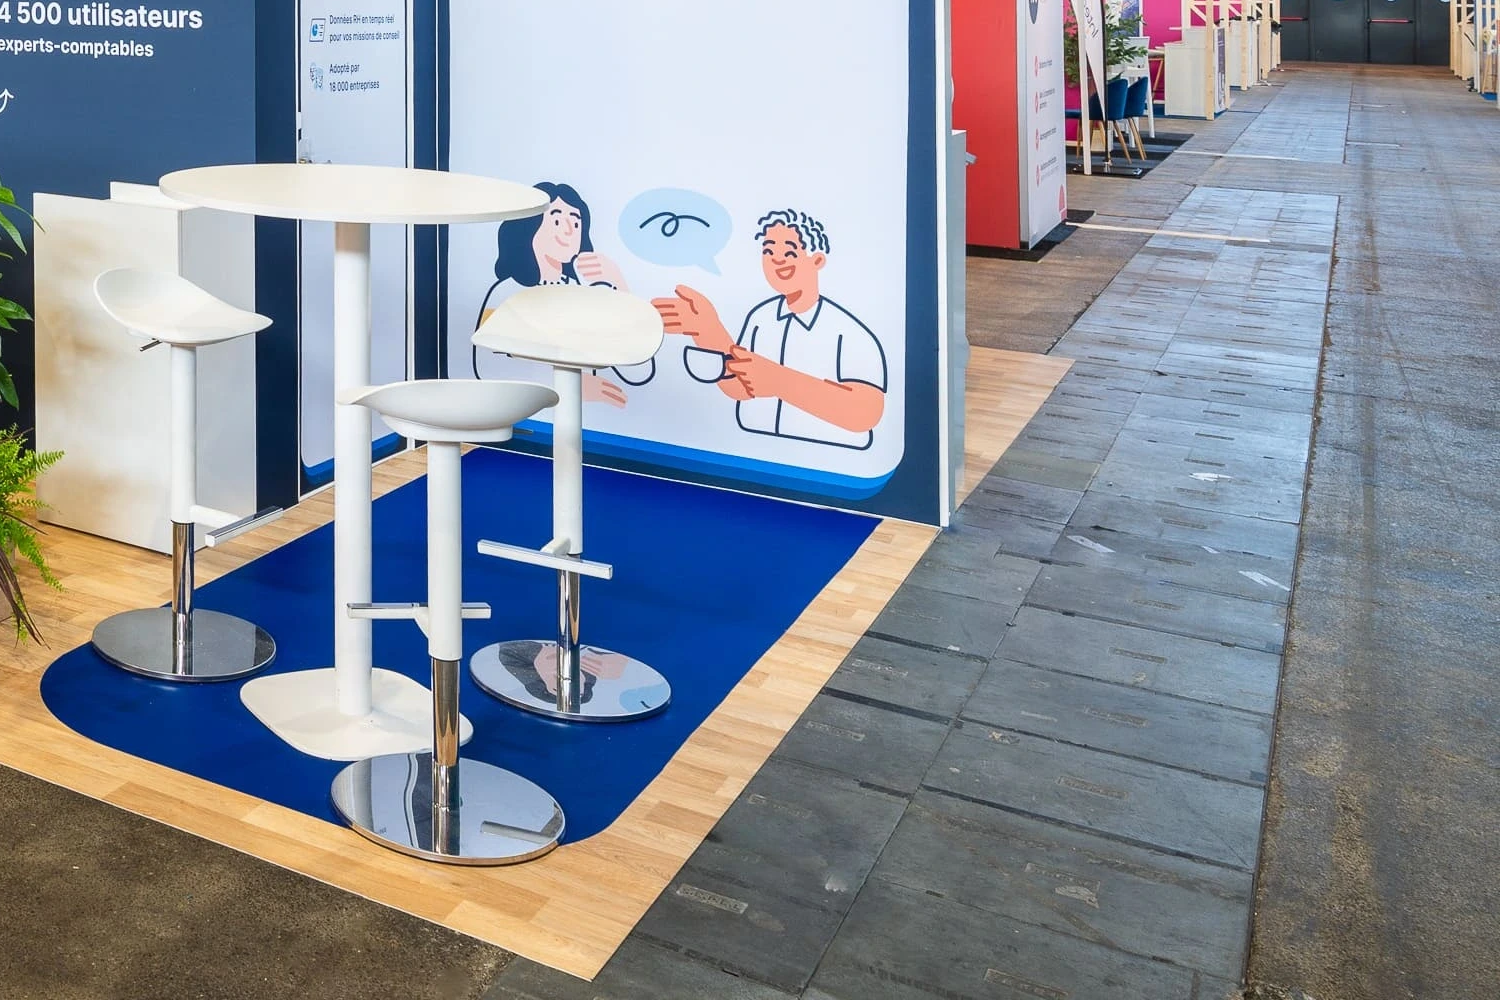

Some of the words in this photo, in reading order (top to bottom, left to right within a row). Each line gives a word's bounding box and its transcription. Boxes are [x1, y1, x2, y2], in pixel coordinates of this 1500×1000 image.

[17, 2, 62, 25] 500
[67, 2, 203, 29] utilisateurs
[329, 14, 352, 24] Données
[353, 14, 360, 23] RH
[369, 15, 384, 24] temps
[385, 14, 395, 23] réel
[329, 34, 342, 44] pour
[352, 32, 375, 40] missions
[376, 31, 382, 40] de
[382, 30, 400, 40] conseil
[329, 63, 349, 75] Adopté
[350, 64, 360, 75] par
[336, 81, 349, 92] 000
[349, 80, 379, 91] entreprises
